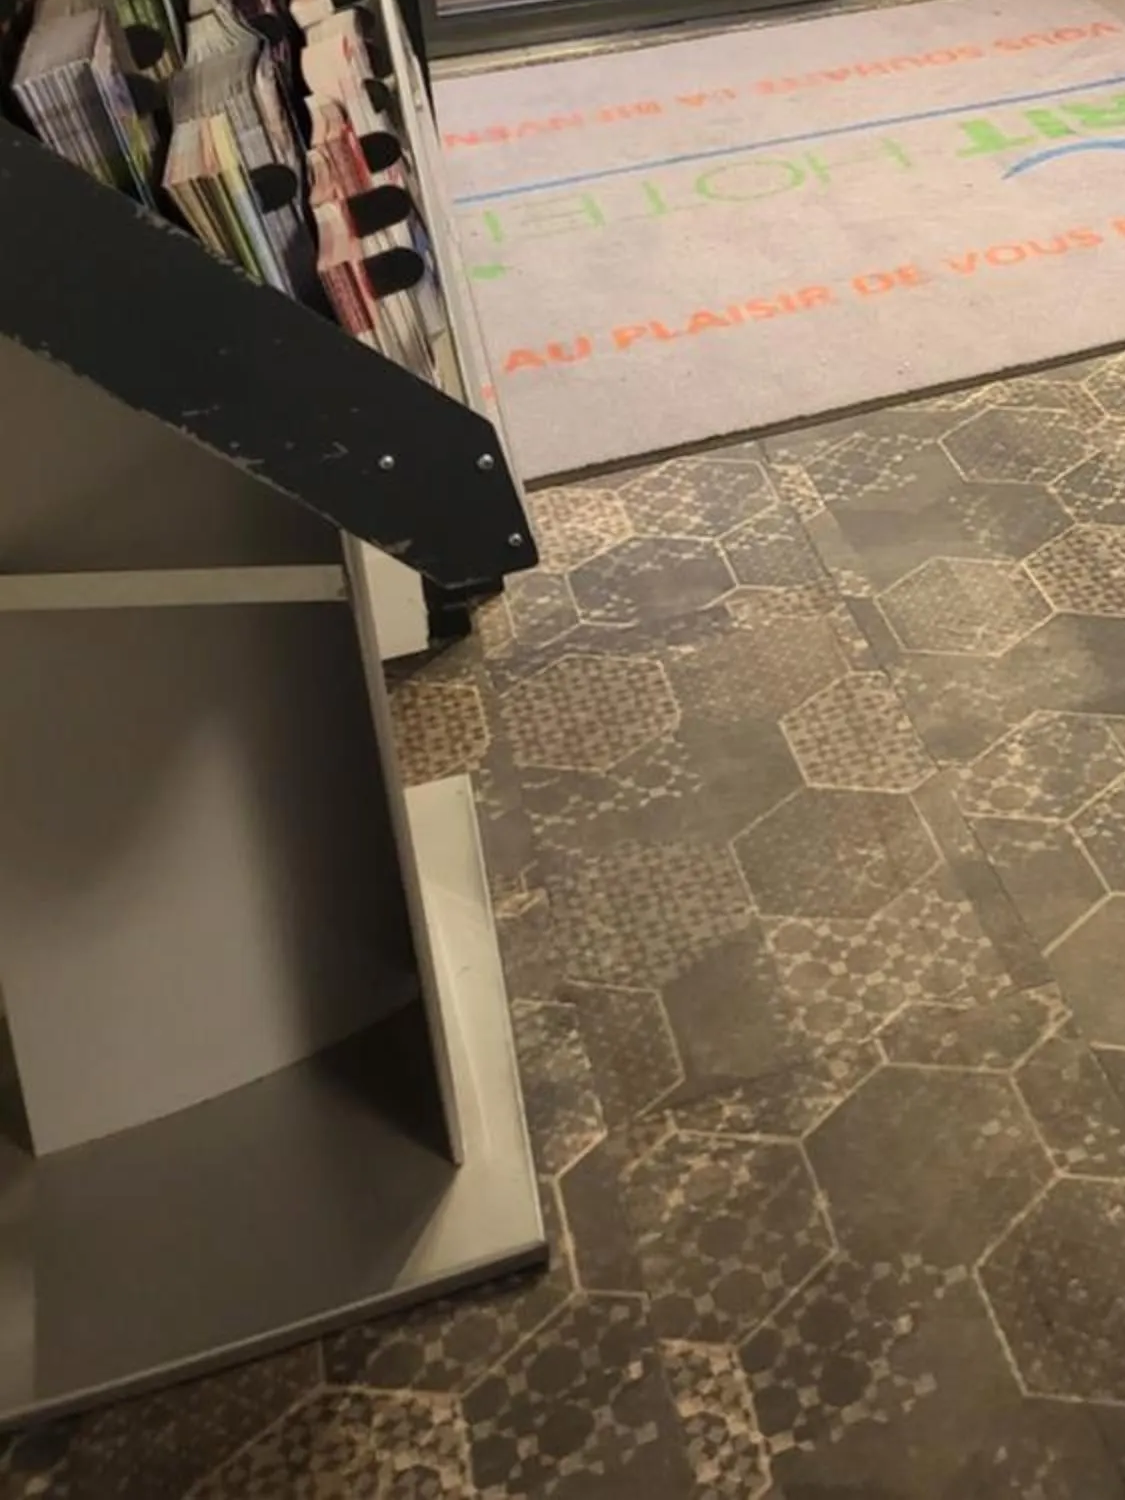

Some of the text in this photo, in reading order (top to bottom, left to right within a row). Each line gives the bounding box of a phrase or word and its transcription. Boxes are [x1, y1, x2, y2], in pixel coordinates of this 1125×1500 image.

[993, 21, 1124, 52] VOUS
[501, 336, 594, 378] AU
[611, 284, 837, 350] PLAISIR
[851, 263, 926, 297] DE
[948, 227, 1104, 276] VOUS
